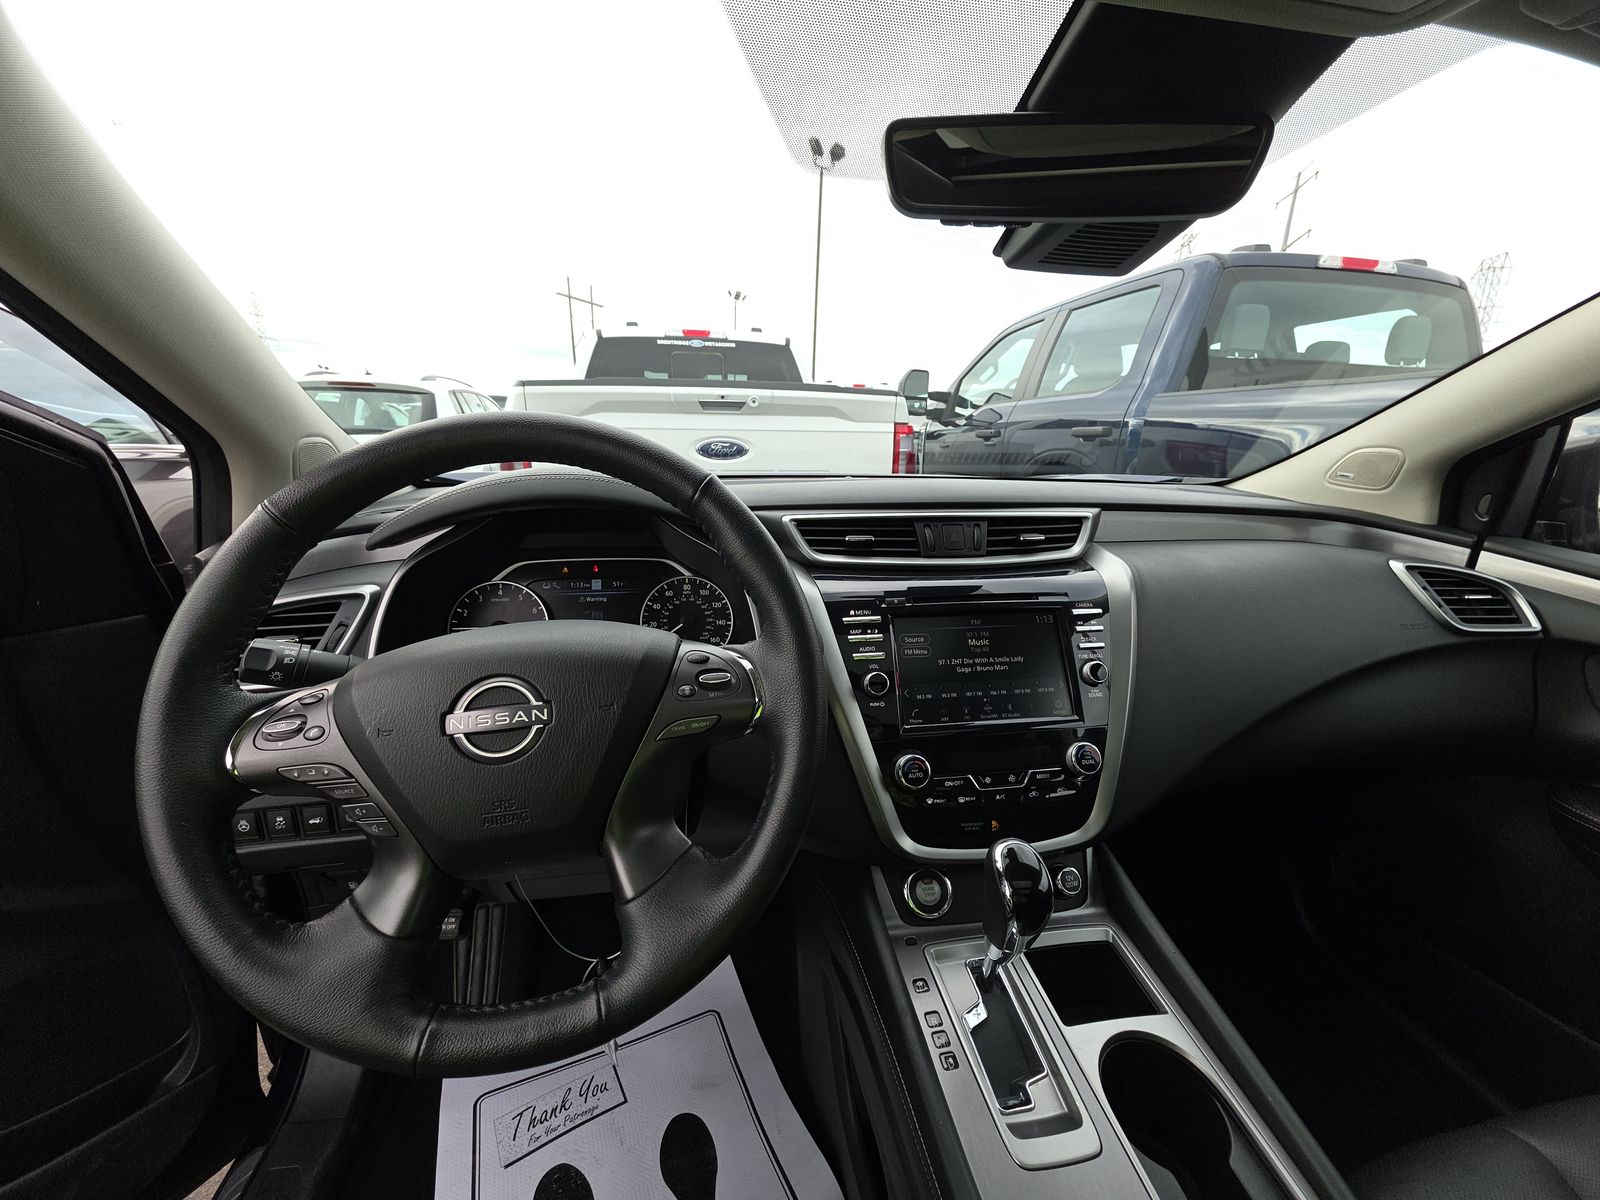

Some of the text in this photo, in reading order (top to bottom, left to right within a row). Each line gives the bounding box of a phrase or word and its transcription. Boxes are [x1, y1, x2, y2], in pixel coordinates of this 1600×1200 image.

[708, 442, 737, 455] Ford
[1035, 614, 1054, 624] 1:13
[449, 708, 548, 730] NISSAN
[492, 799, 516, 812] SRS
[481, 811, 531, 828] AIRBAG
[512, 1075, 609, 1142] Thank You
[527, 1104, 599, 1148] For Your Patronage
